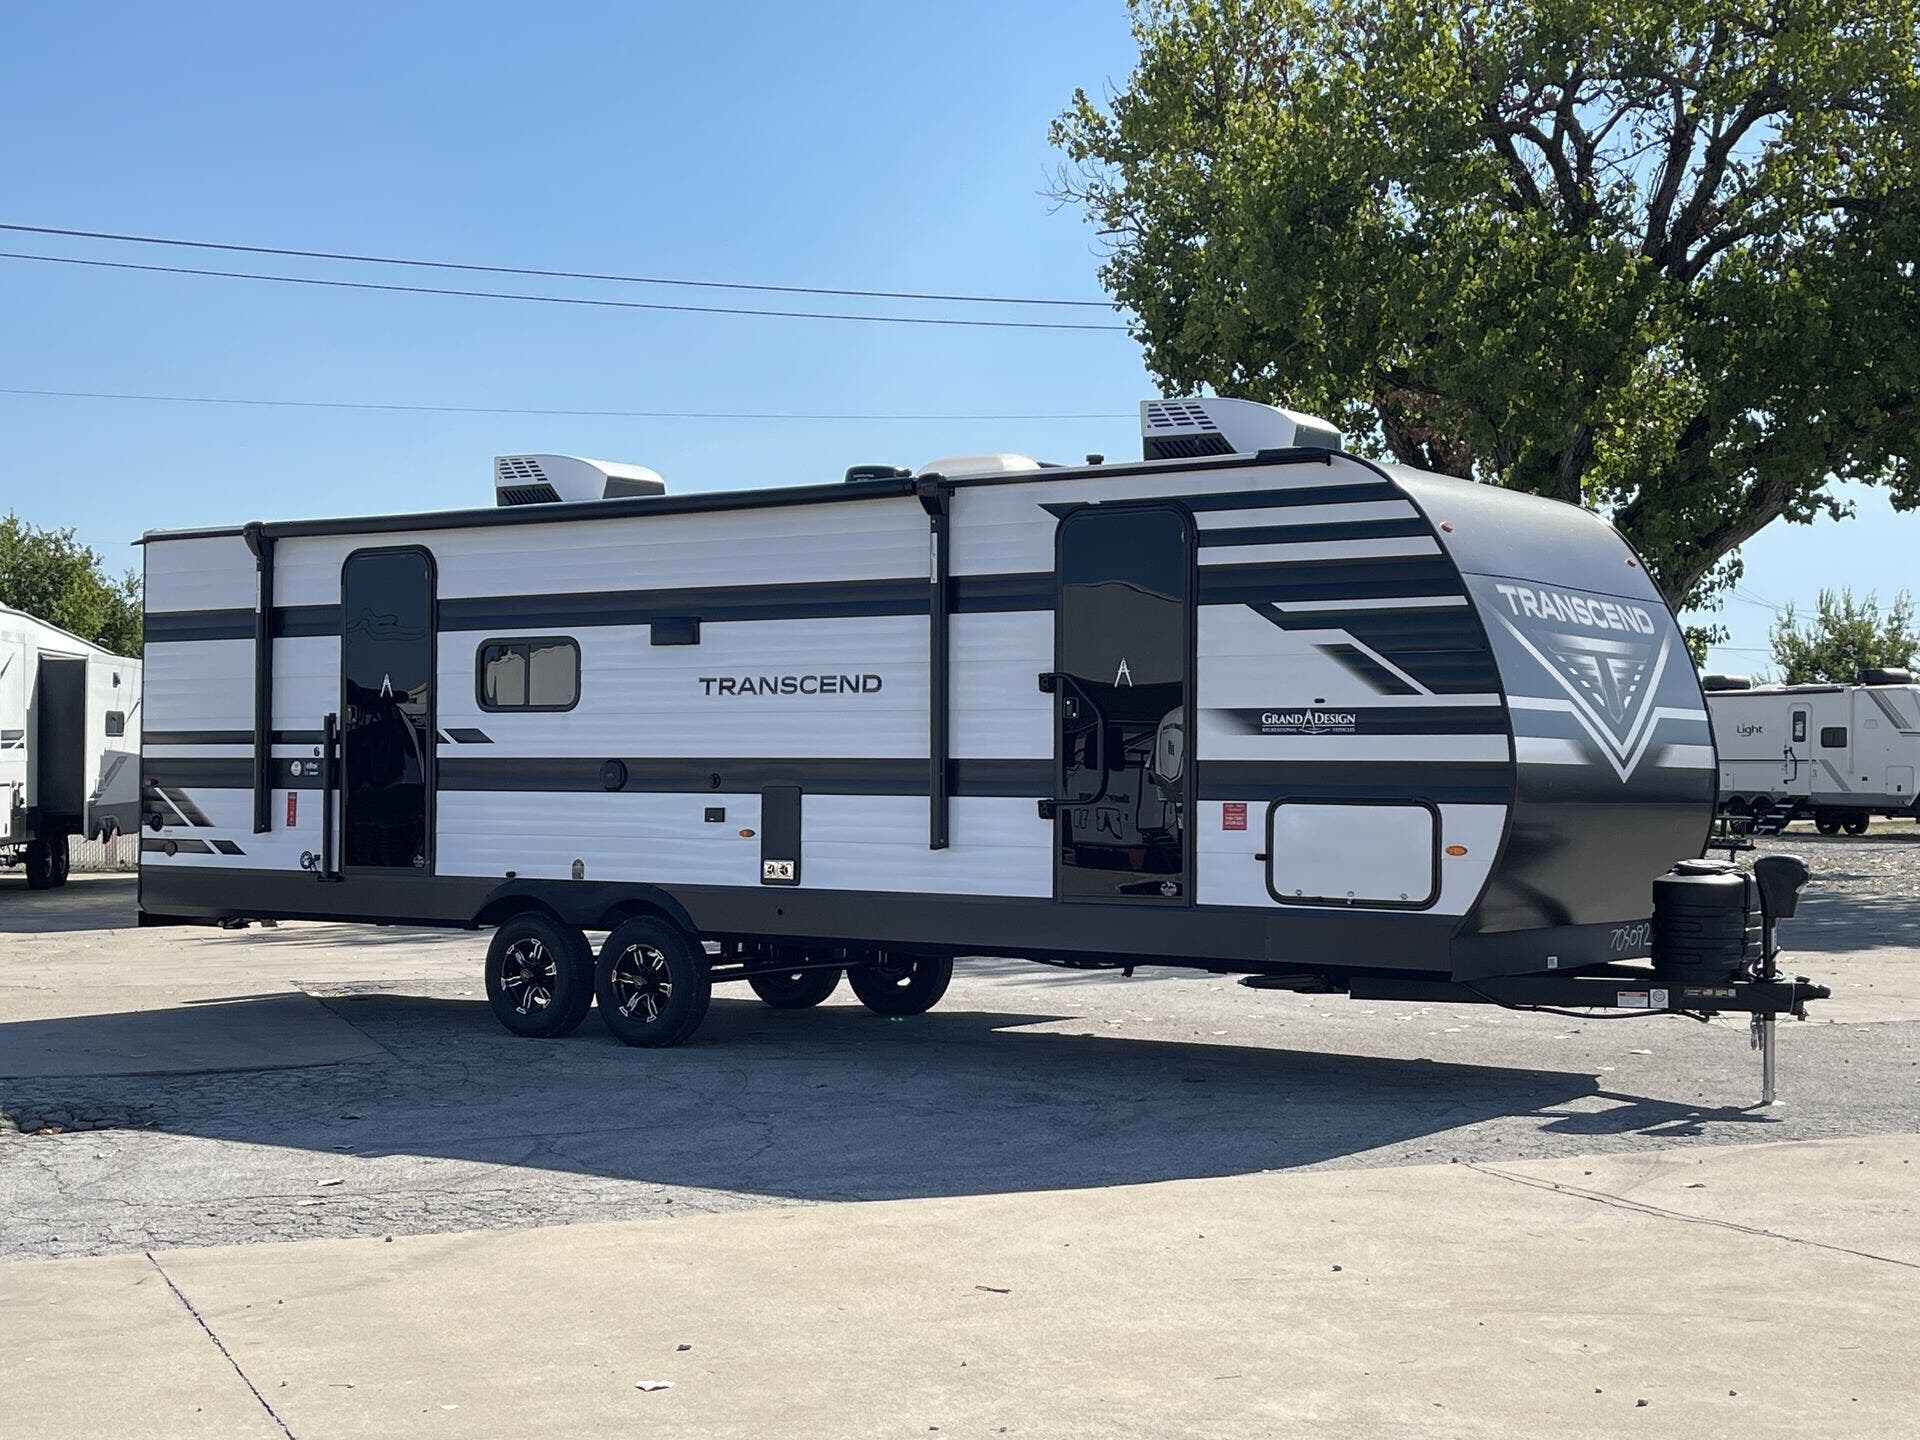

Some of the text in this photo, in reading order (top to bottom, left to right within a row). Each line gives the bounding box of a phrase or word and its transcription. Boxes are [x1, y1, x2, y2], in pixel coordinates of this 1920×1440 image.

[1496, 584, 1655, 635] TRANSCEND
[699, 674, 883, 696] TRANSCEND
[1261, 712, 1356, 724] GRAND DESIGN
[1736, 723, 1764, 737] Light
